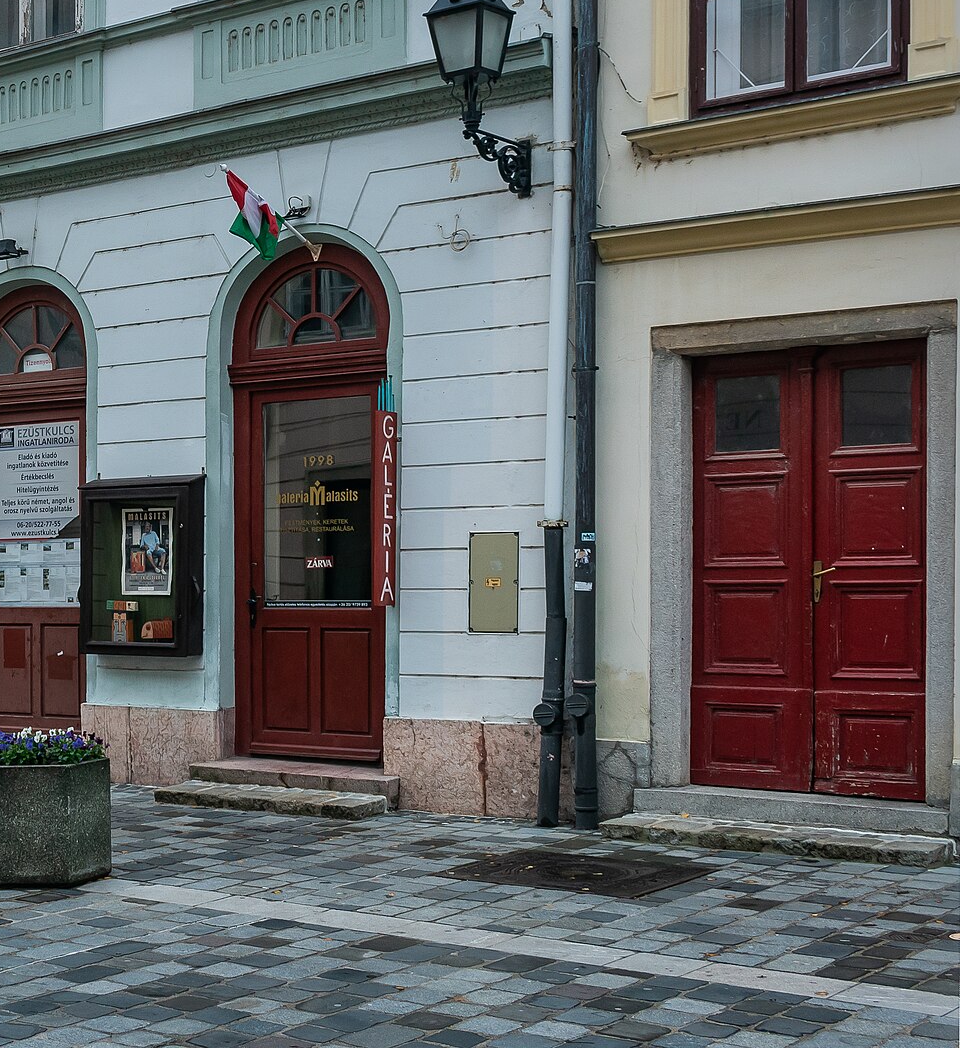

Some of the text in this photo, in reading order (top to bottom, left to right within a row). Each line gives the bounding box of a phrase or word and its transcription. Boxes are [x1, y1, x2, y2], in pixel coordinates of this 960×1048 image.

[18, 425, 75, 438] EZÜSTKULCS
[18, 436, 75, 447] INGATLANIRODA
[7, 461, 36, 470] ingatlanok
[303, 455, 334, 467] 1998
[21, 473, 55, 481] Értékbecslés
[16, 485, 59, 494] Hitelügyintézés
[52, 497, 68, 505] angol
[39, 506, 73, 514] szolgáltatás
[380, 415, 394, 602] GALÉRIA
[128, 512, 167, 521] MALASITS
[306, 557, 333, 569] ZÁRVA
